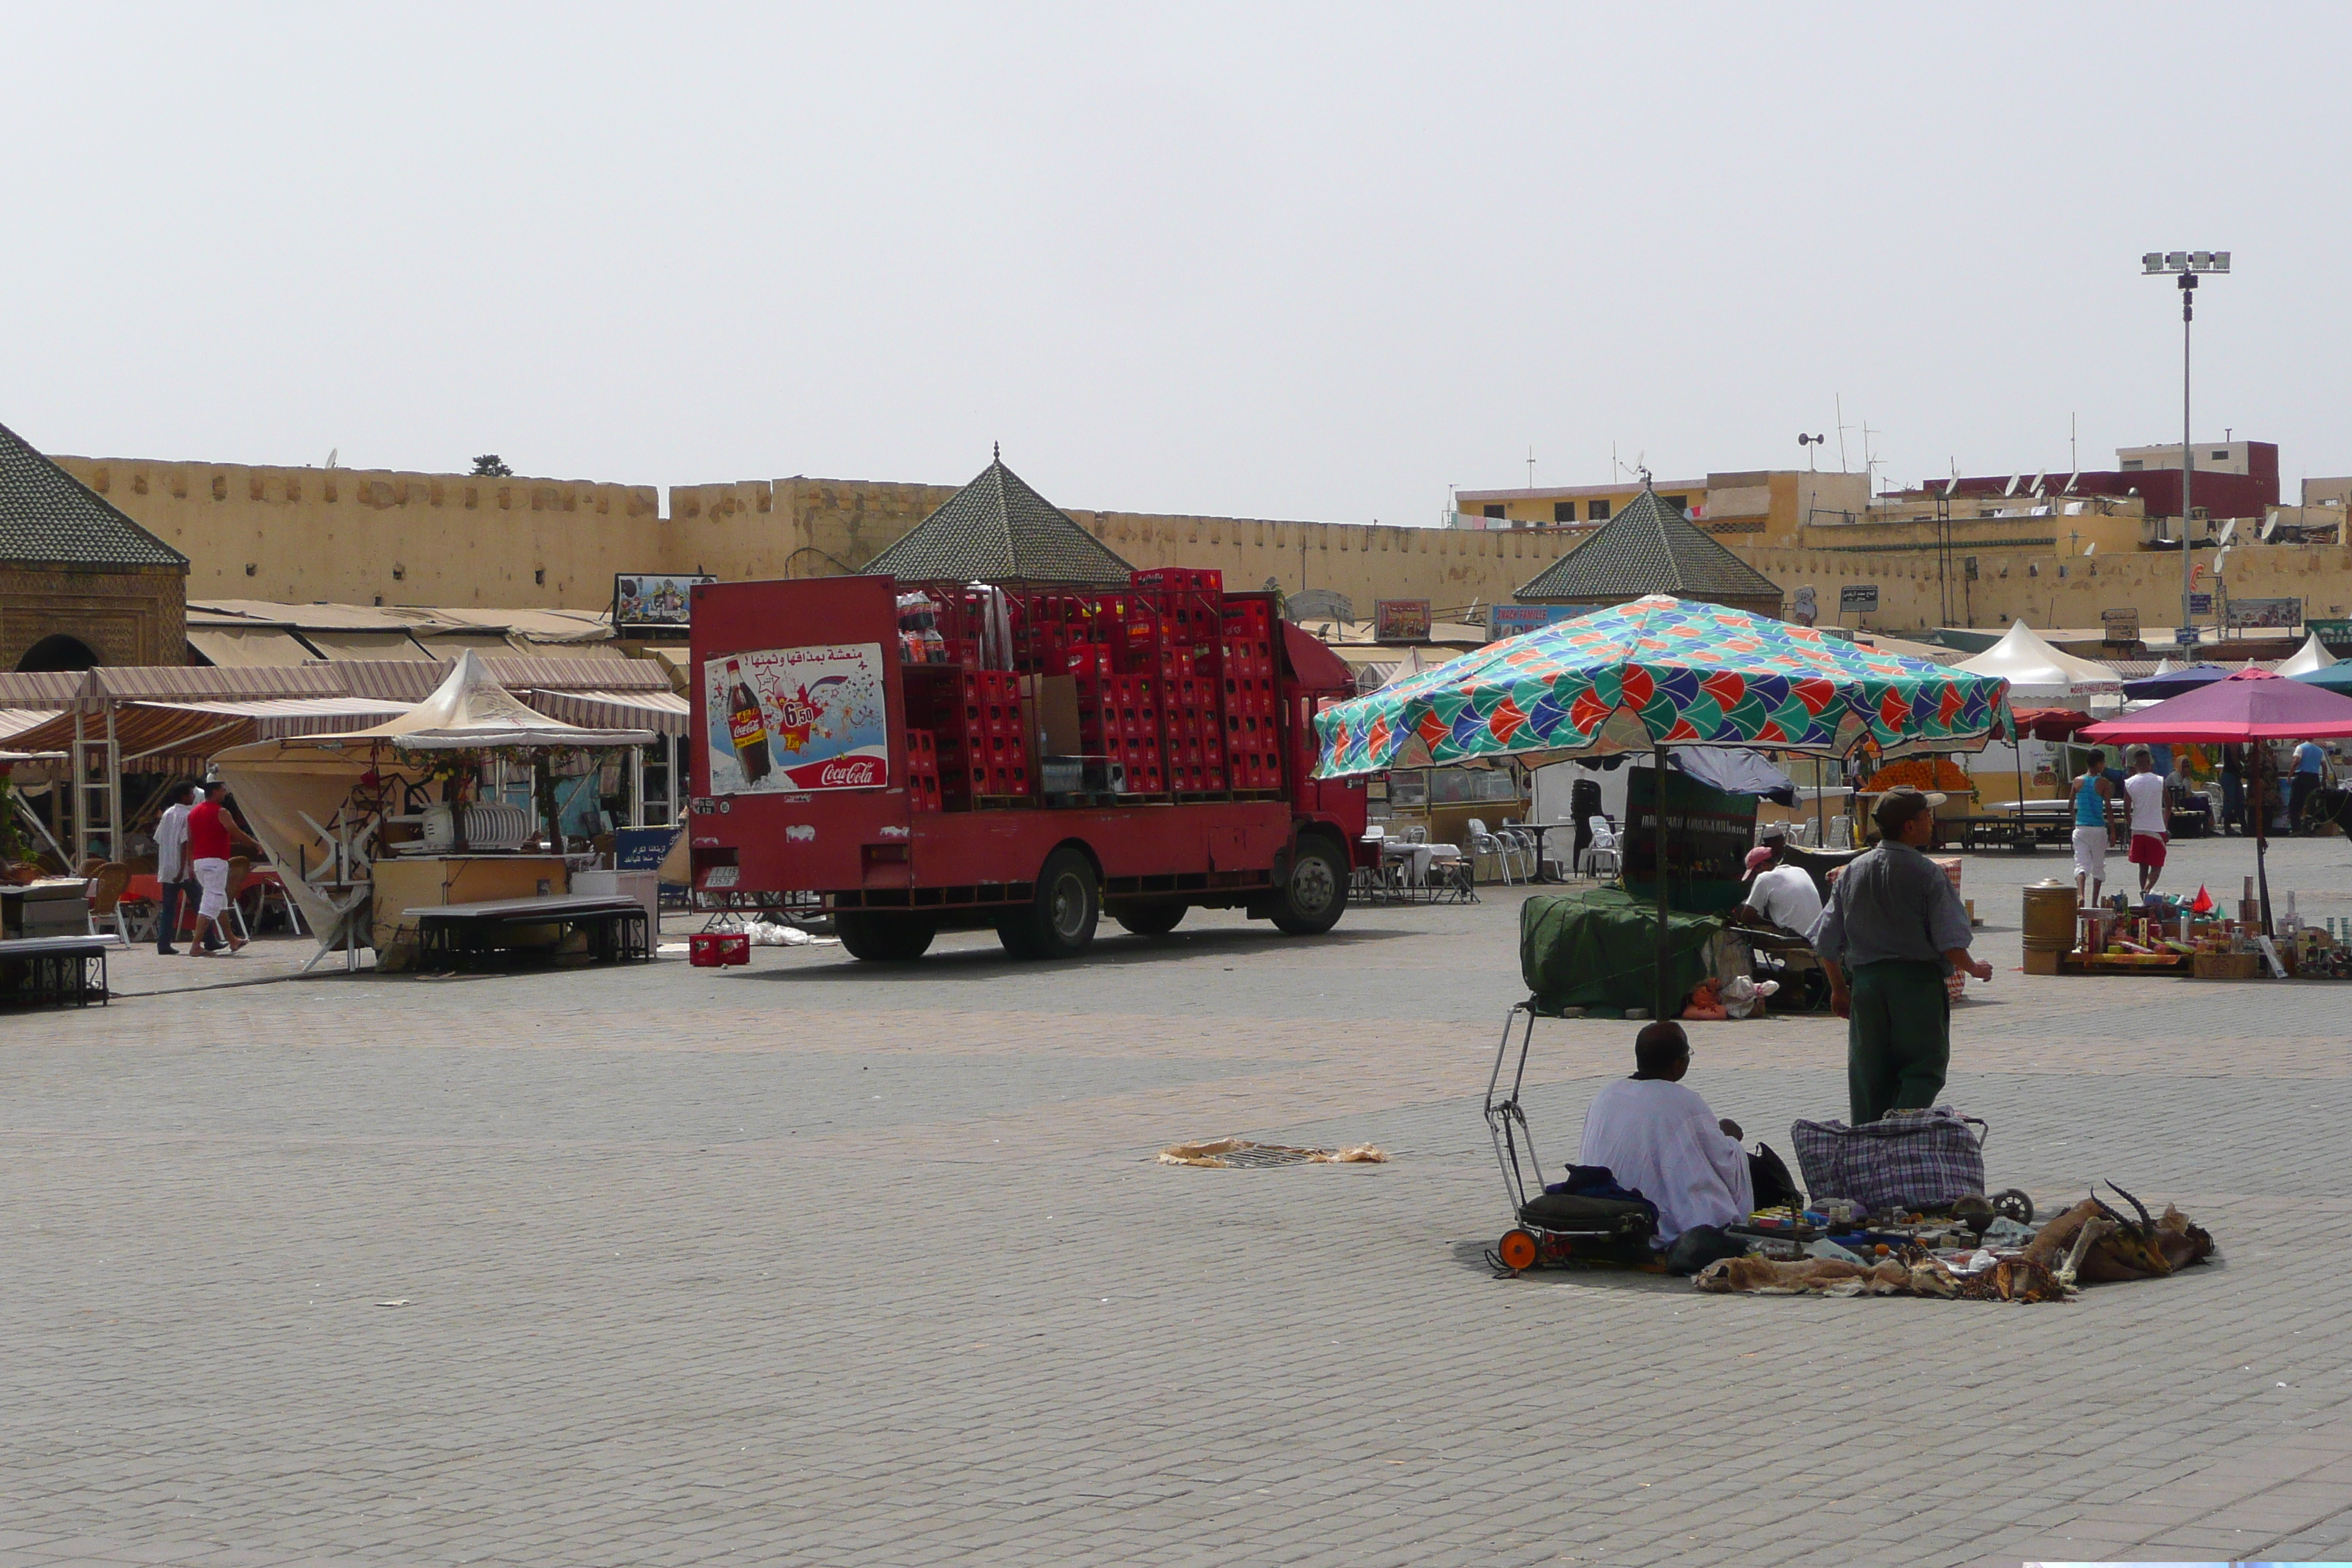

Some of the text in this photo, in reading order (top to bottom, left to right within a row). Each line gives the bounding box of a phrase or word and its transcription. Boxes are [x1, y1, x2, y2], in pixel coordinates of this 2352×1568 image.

[1497, 608, 1518, 620] SNACK
[1520, 608, 1548, 620] FAMILLE
[787, 650, 826, 666] بمذاقها
[828, 649, 862, 660] منعشة
[821, 762, 875, 785] Coca-Cola
